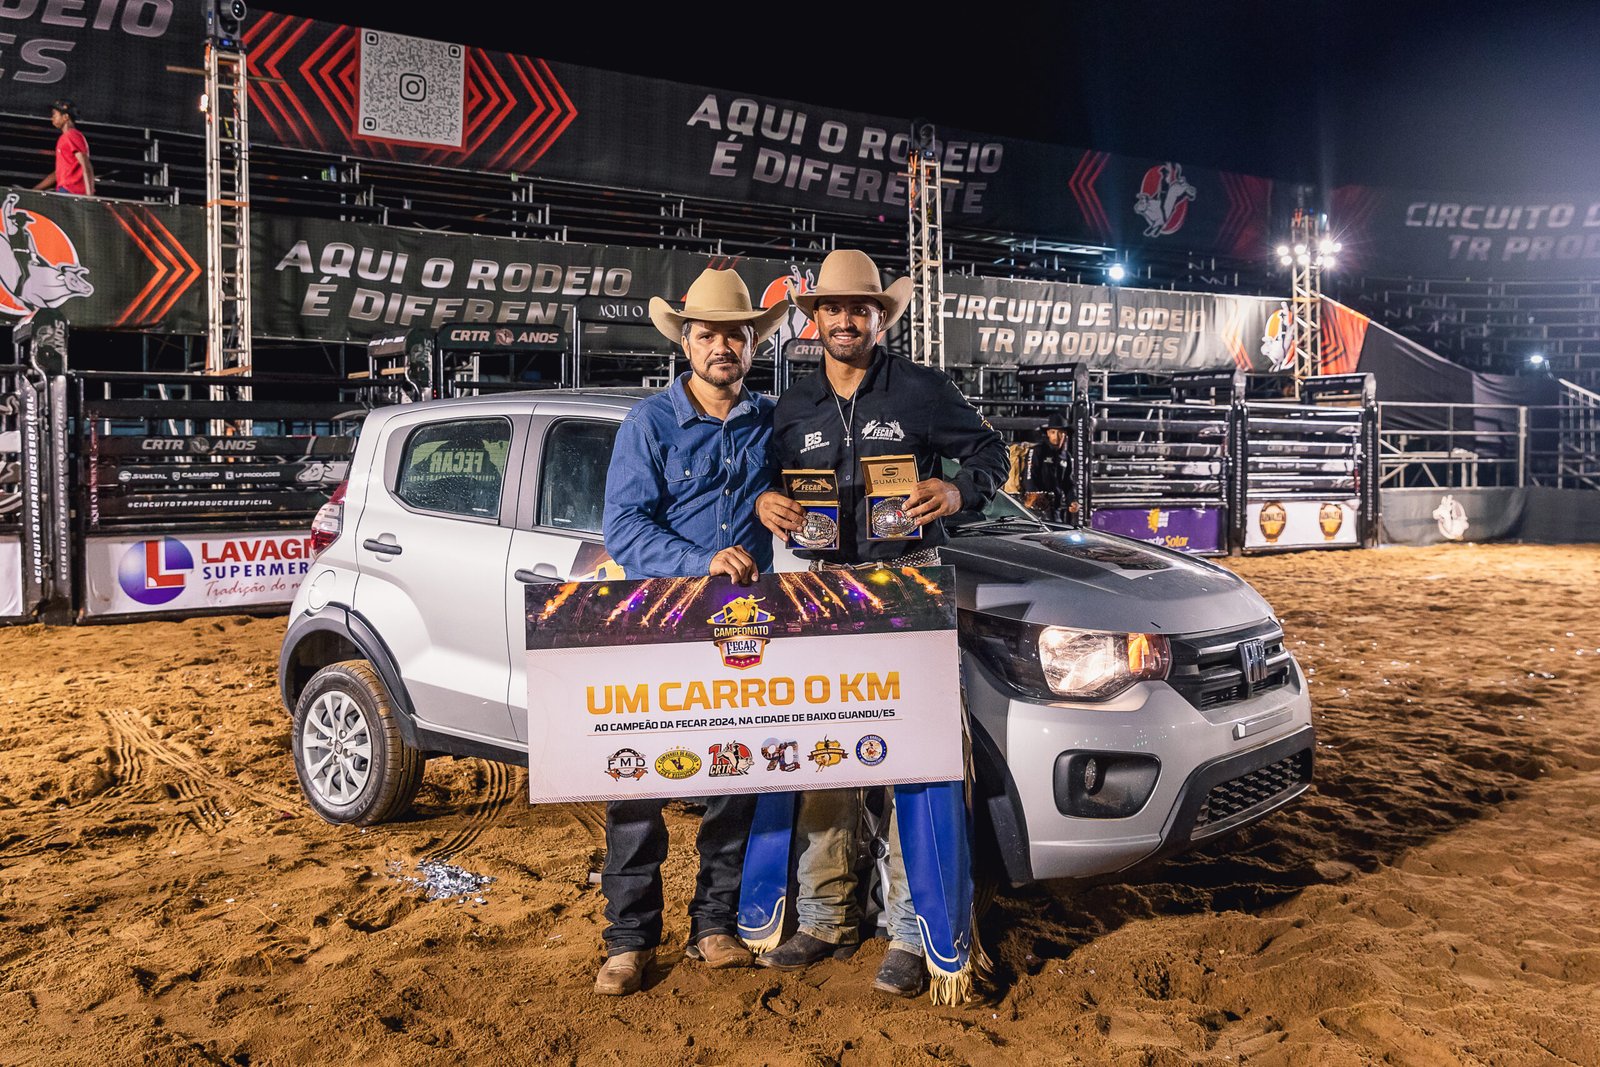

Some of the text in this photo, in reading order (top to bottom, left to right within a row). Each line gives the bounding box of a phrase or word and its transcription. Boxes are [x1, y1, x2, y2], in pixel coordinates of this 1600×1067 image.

[687, 94, 807, 145] AQUI
[819, 120, 848, 154] O
[709, 135, 988, 214] É DIFERETE
[1405, 201, 1576, 230] CIRCUITO
[1448, 234, 1492, 262] TR
[275, 240, 633, 297] AQUI O RODEIO
[301, 276, 608, 334] É DIFERENT
[599, 303, 644, 319] AQUI O
[940, 292, 1206, 333] CIRCUITO DE RODEIO
[451, 329, 560, 344] CRTR ANOS
[978, 326, 1016, 354] TR
[794, 344, 824, 356] CRTR
[142, 439, 257, 451] CRTR ANOS
[804, 430, 823, 448] BS
[873, 477, 914, 485] SUMETAL
[1165, 535, 1189, 548] Solar
[206, 579, 266, 597] Tradição
[270, 577, 287, 592] do
[713, 625, 769, 638] CAMPEONATO
[725, 639, 758, 655] FECAR
[586, 684, 650, 715] UM
[658, 676, 796, 712] CARRO
[839, 671, 901, 702] KM
[594, 708, 896, 732] AO CAMPEÃO DA FECAR 2024, NA CIDADE DE BAIXO GUANDU/ES
[709, 764, 733, 775] CRTR
